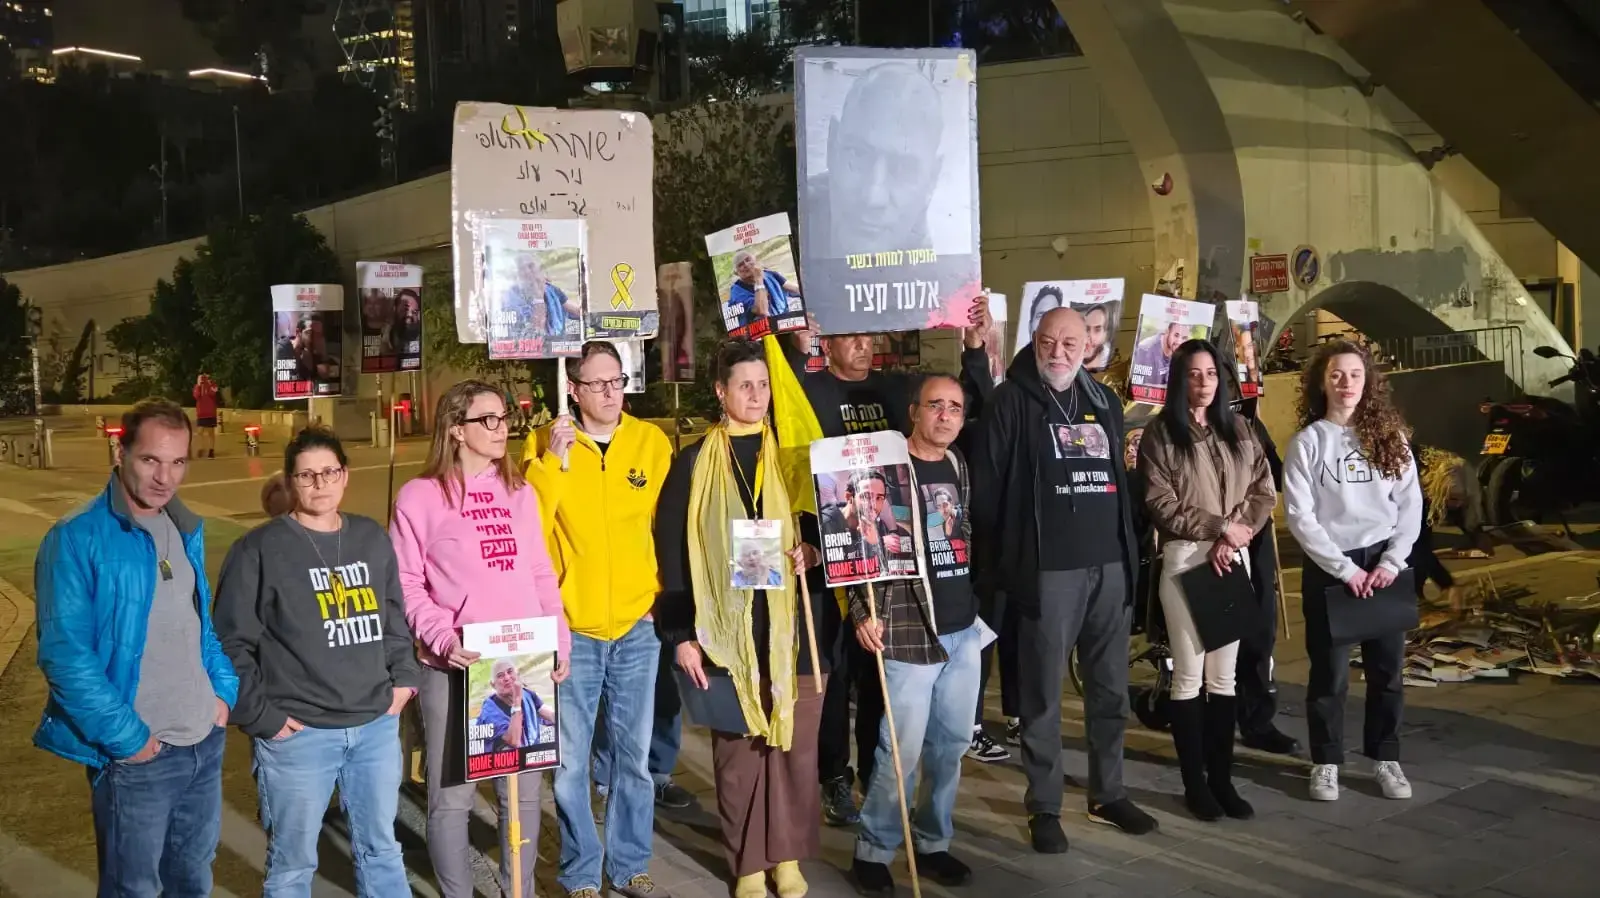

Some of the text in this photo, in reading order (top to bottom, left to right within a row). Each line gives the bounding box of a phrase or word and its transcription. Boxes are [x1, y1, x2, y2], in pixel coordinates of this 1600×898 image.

[844, 252, 873, 270] בשבי
[844, 279, 941, 315] אלעד קציר
[276, 370, 290, 381] HIM
[460, 507, 513, 521] אחיותיי
[475, 523, 513, 536] ואחיי
[824, 531, 852, 548] BRING
[929, 539, 951, 552] BRING
[482, 540, 516, 558] זועק
[826, 547, 844, 562] HIM
[827, 558, 854, 578] HOME
[855, 555, 880, 575] NOW!
[931, 550, 956, 566] HOME
[308, 560, 370, 591] למה הם
[468, 722, 494, 740] BRING
[468, 739, 485, 756] HIM
[469, 754, 493, 773] HOME
[494, 748, 519, 768] NOW!
